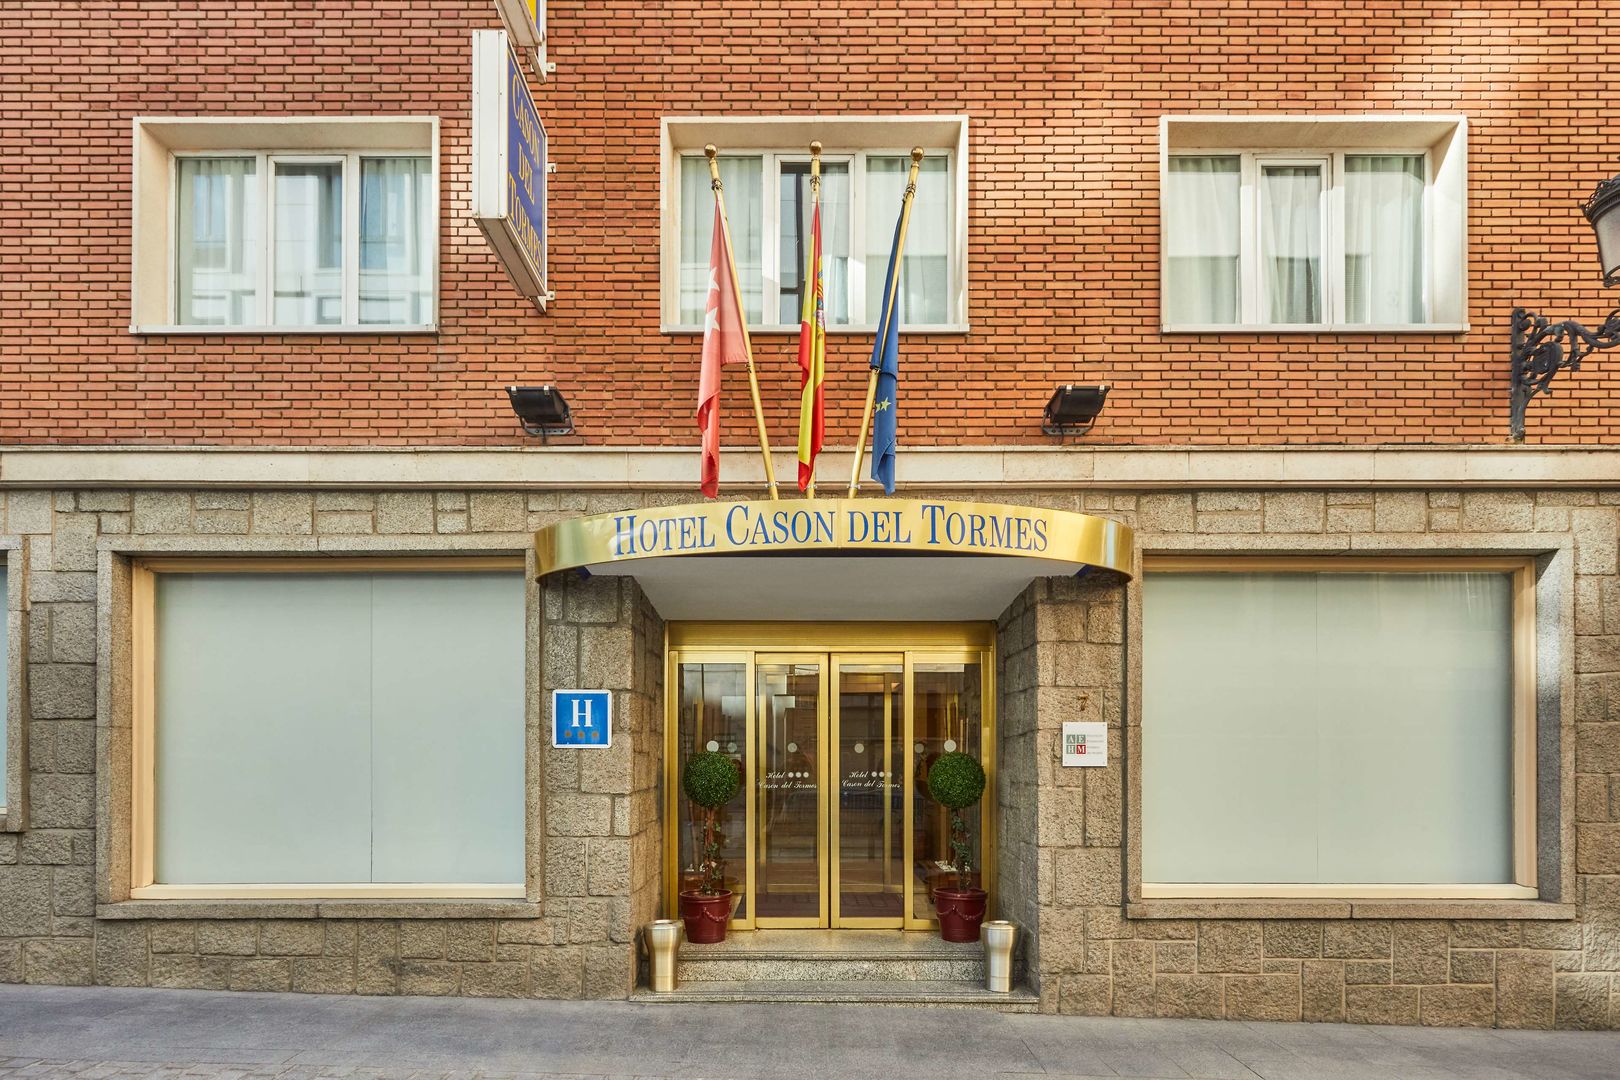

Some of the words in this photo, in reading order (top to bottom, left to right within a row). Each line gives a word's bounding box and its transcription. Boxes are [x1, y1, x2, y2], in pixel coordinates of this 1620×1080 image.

[512, 73, 540, 168] CASON
[518, 142, 535, 205] DEL
[508, 171, 543, 274] TORMES
[614, 514, 716, 556] HOTEL
[725, 504, 836, 546] CASON
[847, 511, 912, 544] DEL
[921, 504, 1048, 552] TORMES
[571, 699, 593, 727] H
[765, 771, 786, 779] Hotel
[780, 781, 793, 789] del
[793, 780, 817, 789] Tormes
[863, 780, 876, 788] del
